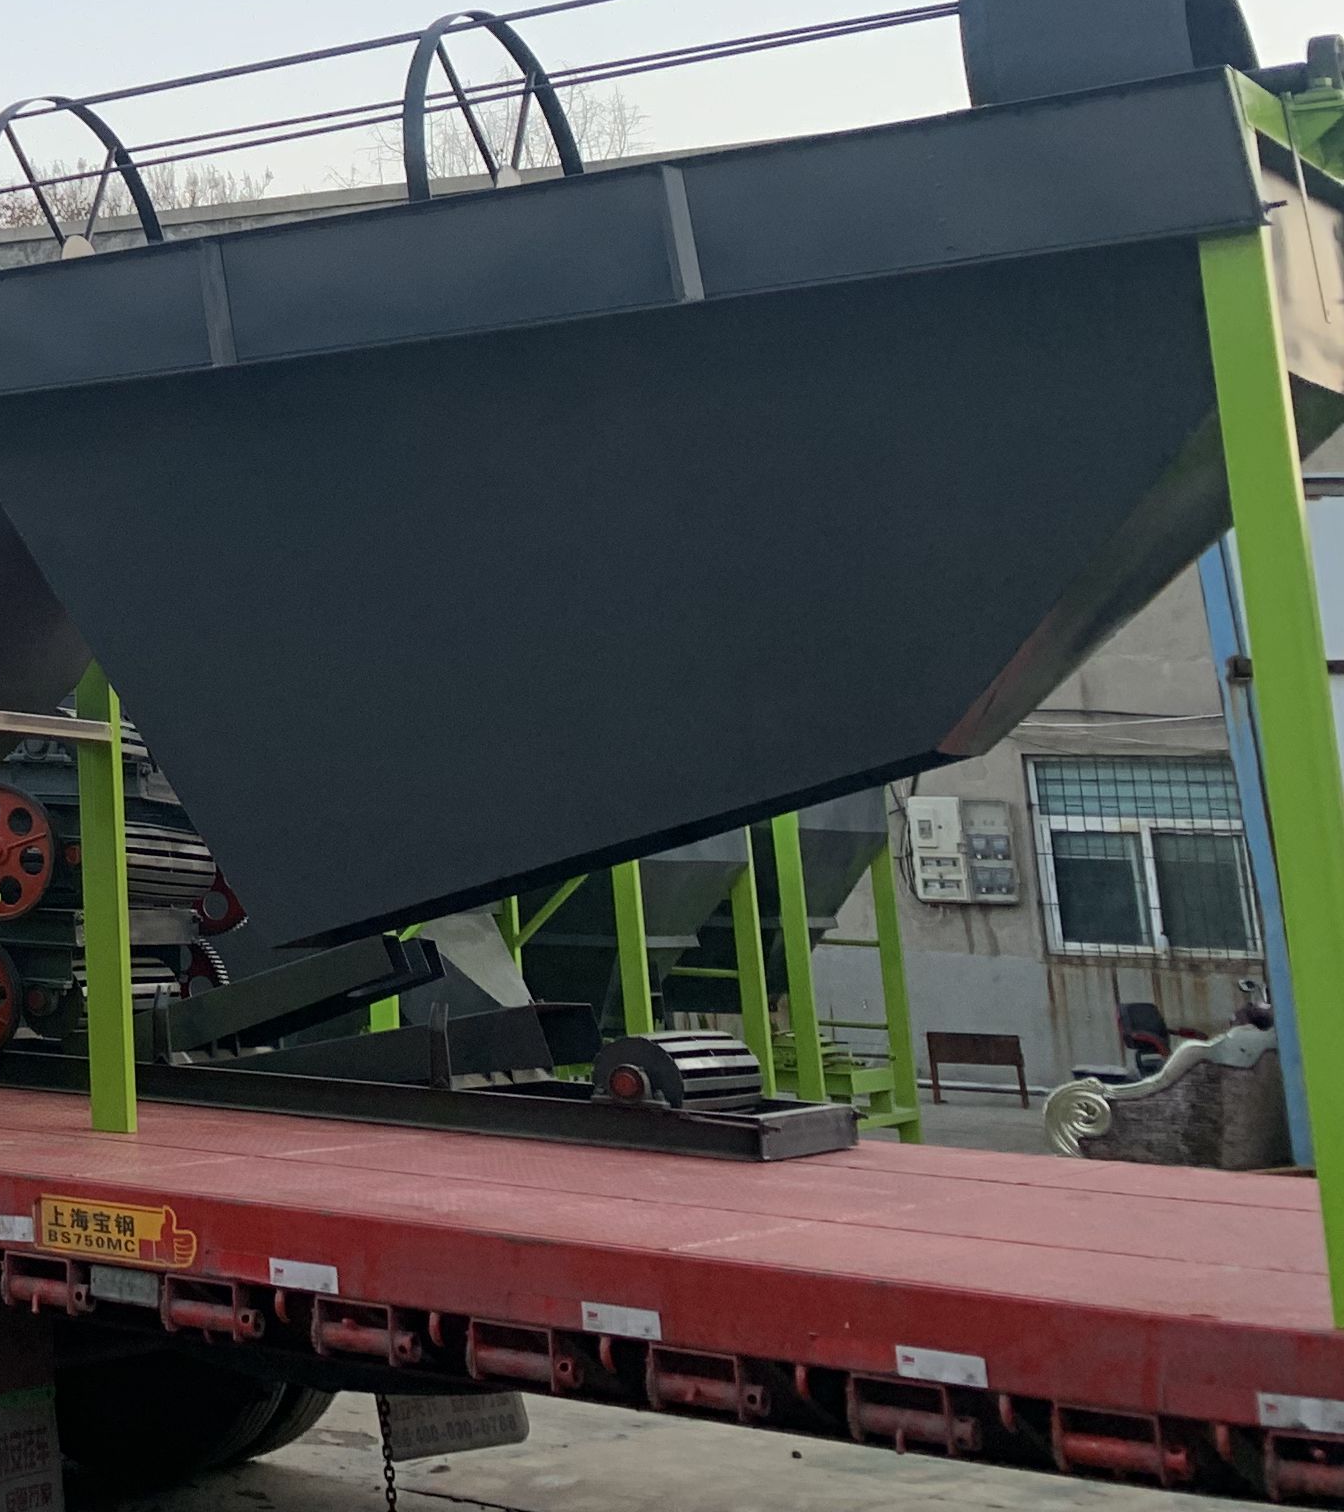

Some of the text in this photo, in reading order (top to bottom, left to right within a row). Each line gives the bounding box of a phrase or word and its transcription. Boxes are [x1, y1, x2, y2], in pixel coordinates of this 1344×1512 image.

[48, 1205, 136, 1238] 上海宝钢
[47, 1229, 137, 1254] BS750MC
